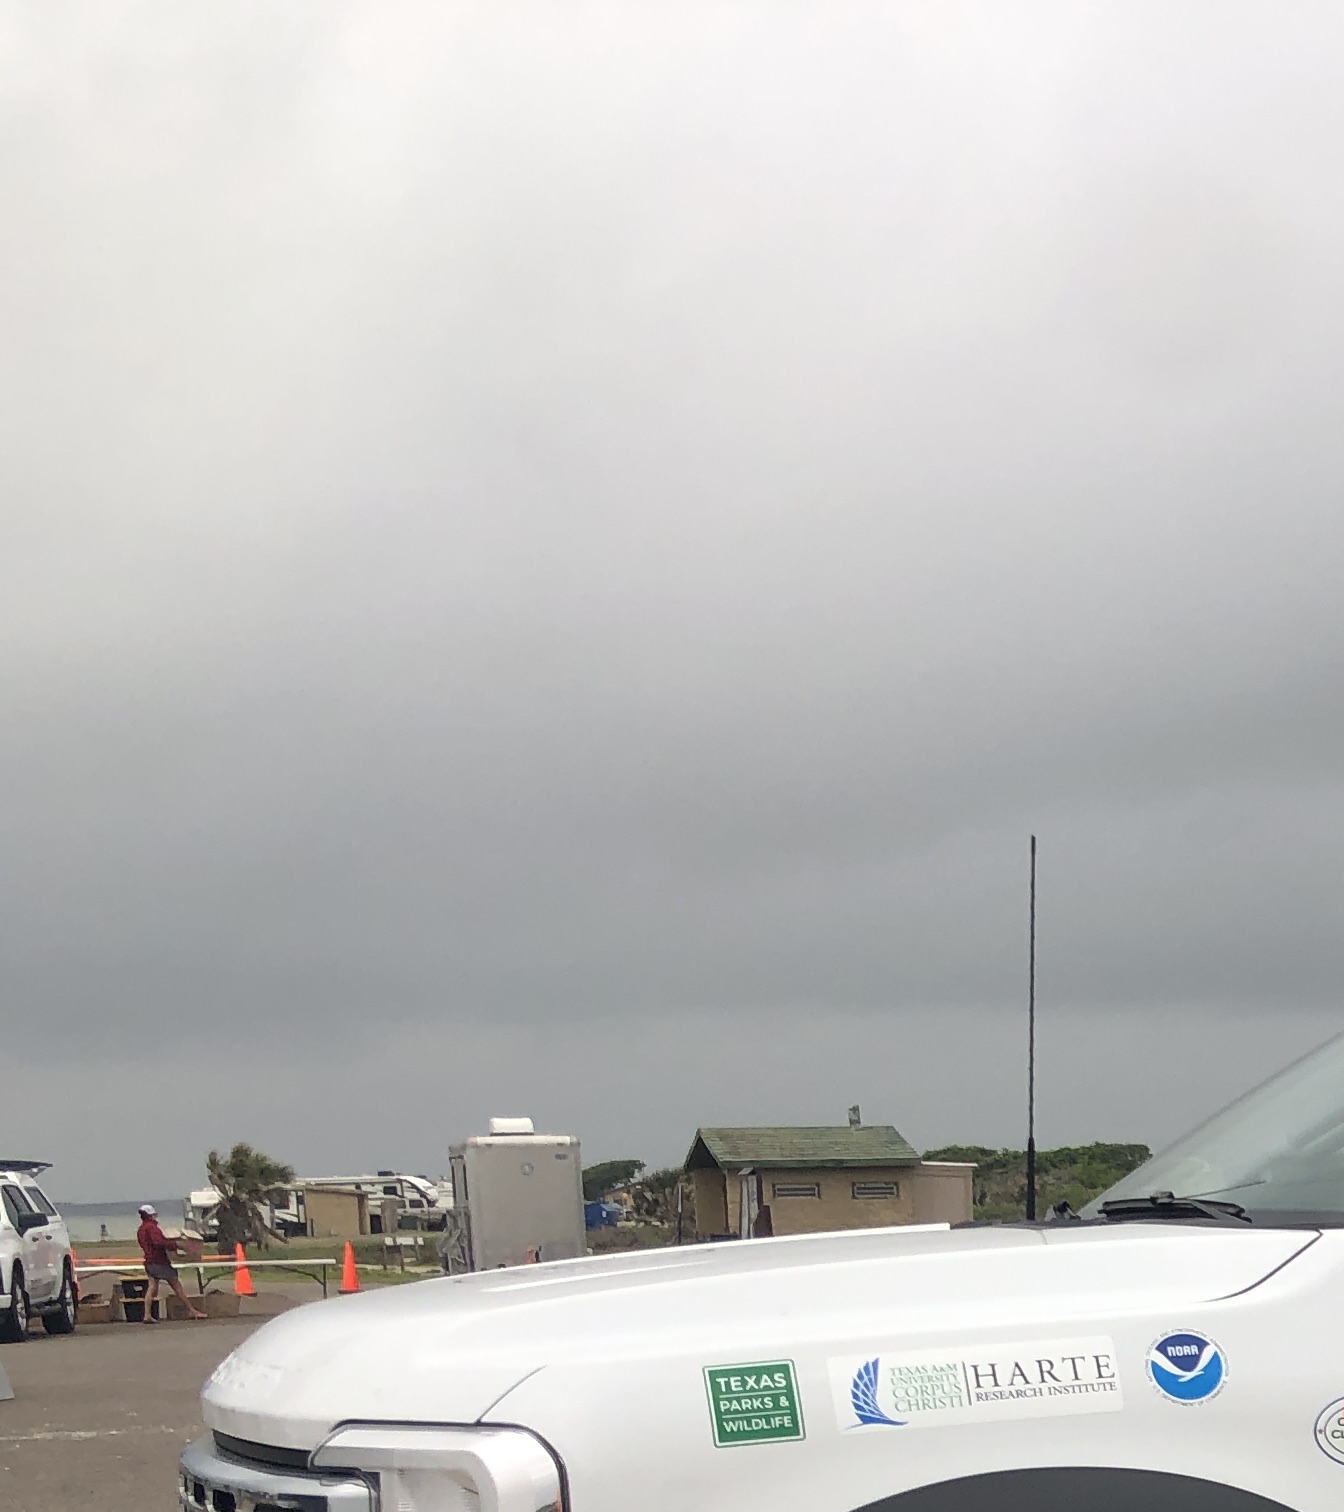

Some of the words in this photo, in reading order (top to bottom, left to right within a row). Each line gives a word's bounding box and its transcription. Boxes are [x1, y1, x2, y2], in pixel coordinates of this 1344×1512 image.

[890, 1365, 928, 1377] TEXAS
[891, 1373, 960, 1386] UNIVERSITY
[970, 1354, 1116, 1389] HARTE
[715, 1372, 787, 1393] TEXAS
[892, 1383, 963, 1399] CORPUS
[975, 1387, 1044, 1402] RESEARCH
[1048, 1381, 1118, 1397] INSTITUTE
[719, 1396, 774, 1413] PARKS
[779, 1395, 789, 1407] &
[894, 1394, 964, 1412] CHRISTI
[723, 1415, 794, 1433] WILDLIFE
